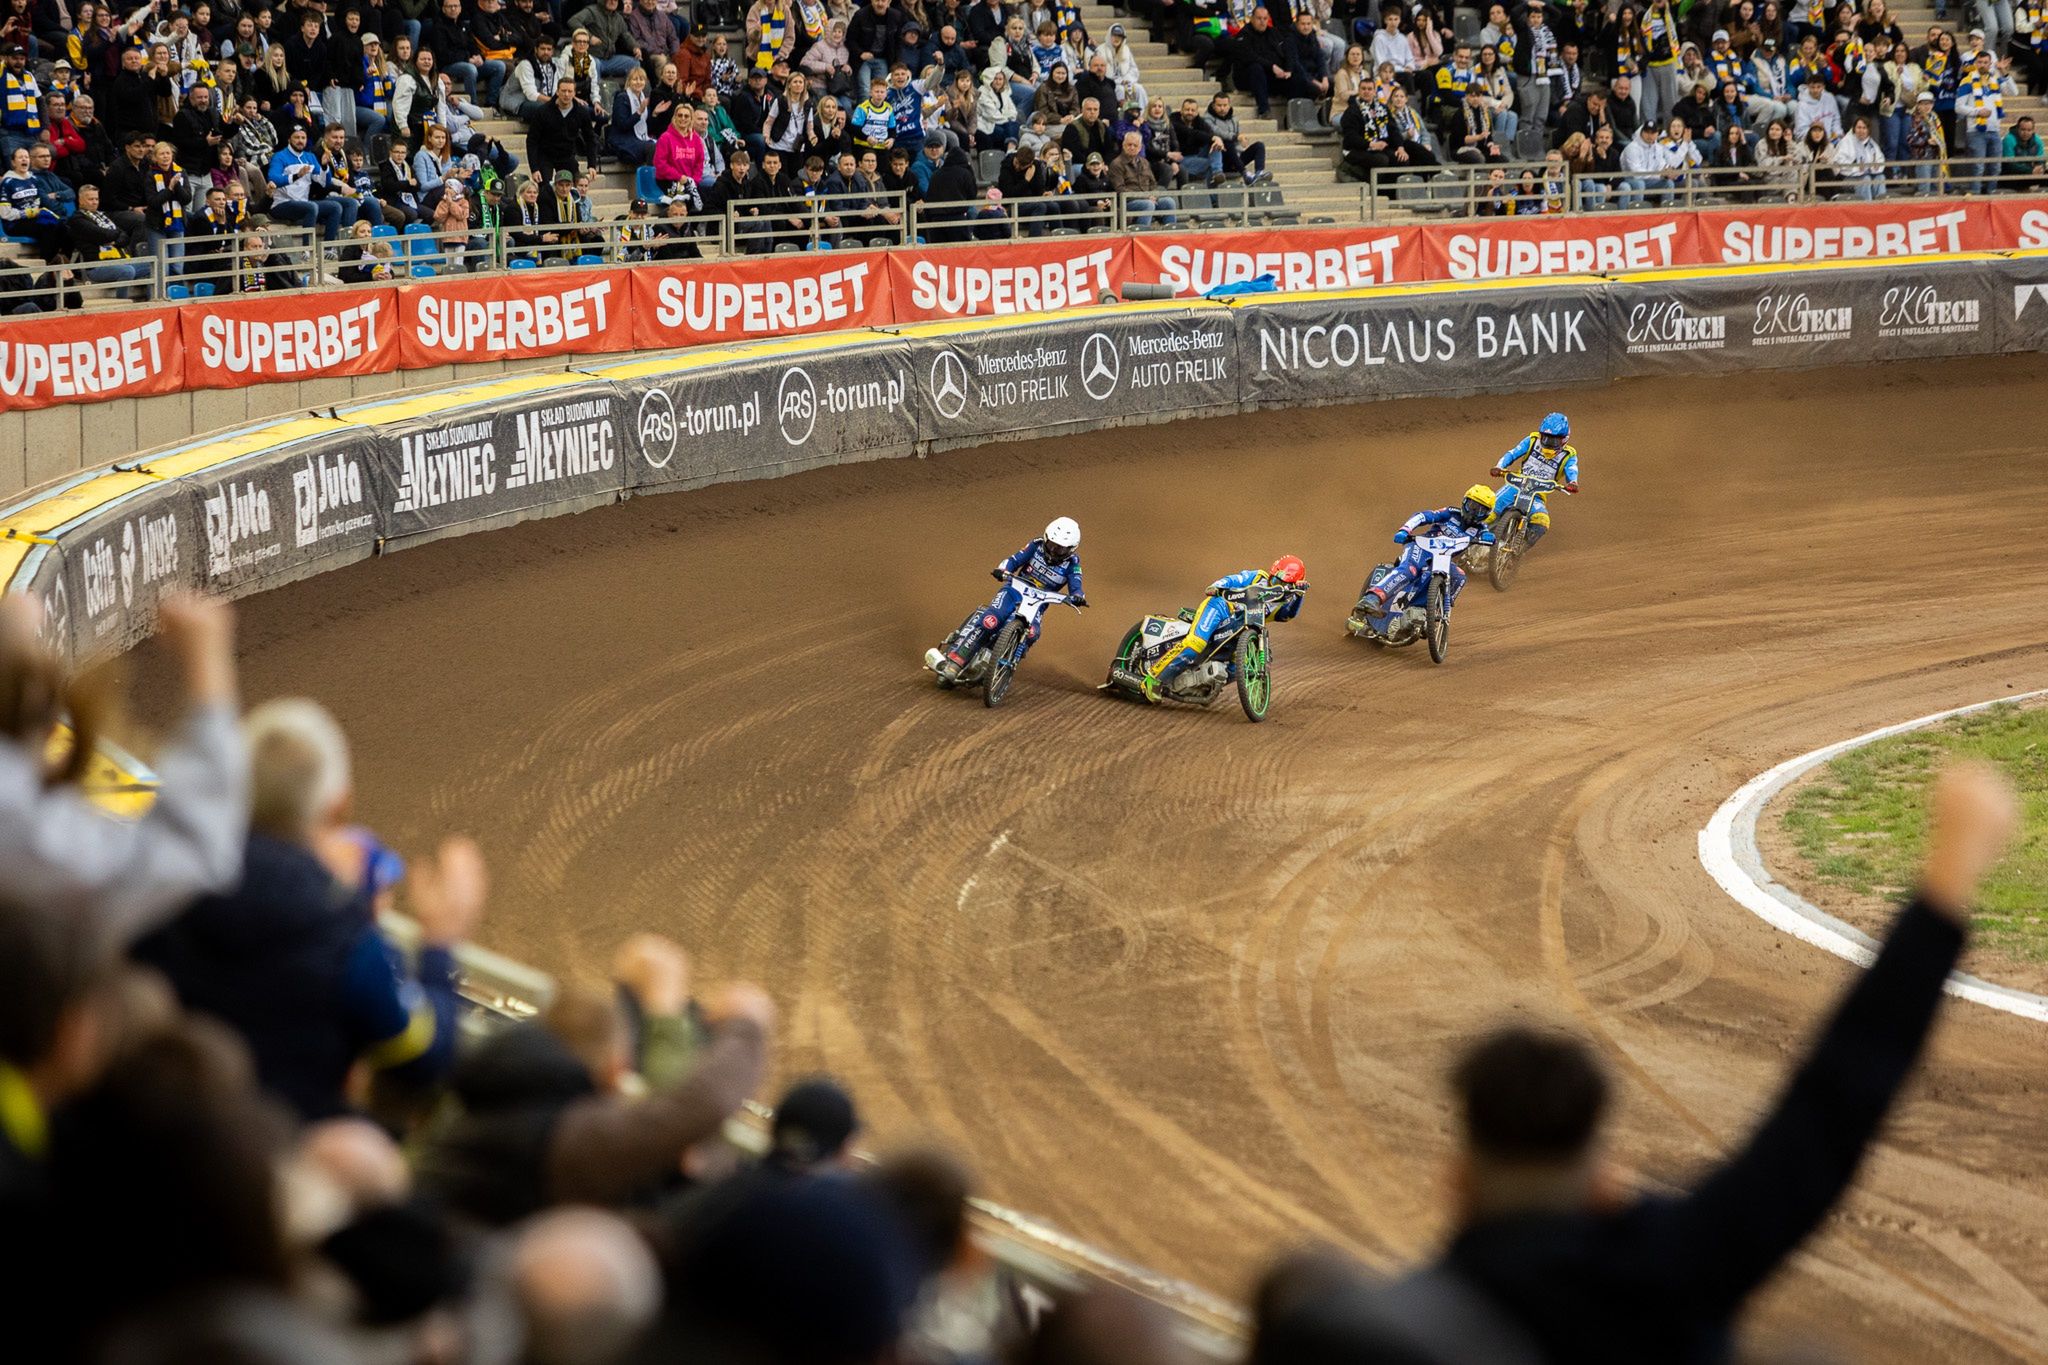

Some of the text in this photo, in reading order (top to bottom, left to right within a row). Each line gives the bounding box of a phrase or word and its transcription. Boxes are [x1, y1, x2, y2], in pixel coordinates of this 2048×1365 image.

[1448, 222, 1677, 279] SUPERBET
[1721, 209, 1966, 263] SUPERBET
[656, 262, 869, 332] SUPERBET
[911, 248, 1113, 315] SUPERBET
[201, 298, 381, 373] SUPERBET
[416, 280, 611, 351] SUPERBET
[1128, 330, 1224, 357] Mercedes-Benz
[1260, 309, 1586, 371] NICOLAUS BANK
[0, 318, 164, 397] UPERBET
[977, 348, 1067, 376] Mercedes-Benz
[1131, 357, 1227, 389] AUTO FRELIK
[541, 398, 610, 428] SKŁAD BUDOWLANY
[979, 375, 1069, 408] AUTO FRELIK
[393, 434, 497, 514] MŁYNIEC
[506, 411, 614, 490] MŁYNIEC
[230, 482, 271, 543] Juta
[318, 454, 362, 513] Juta
